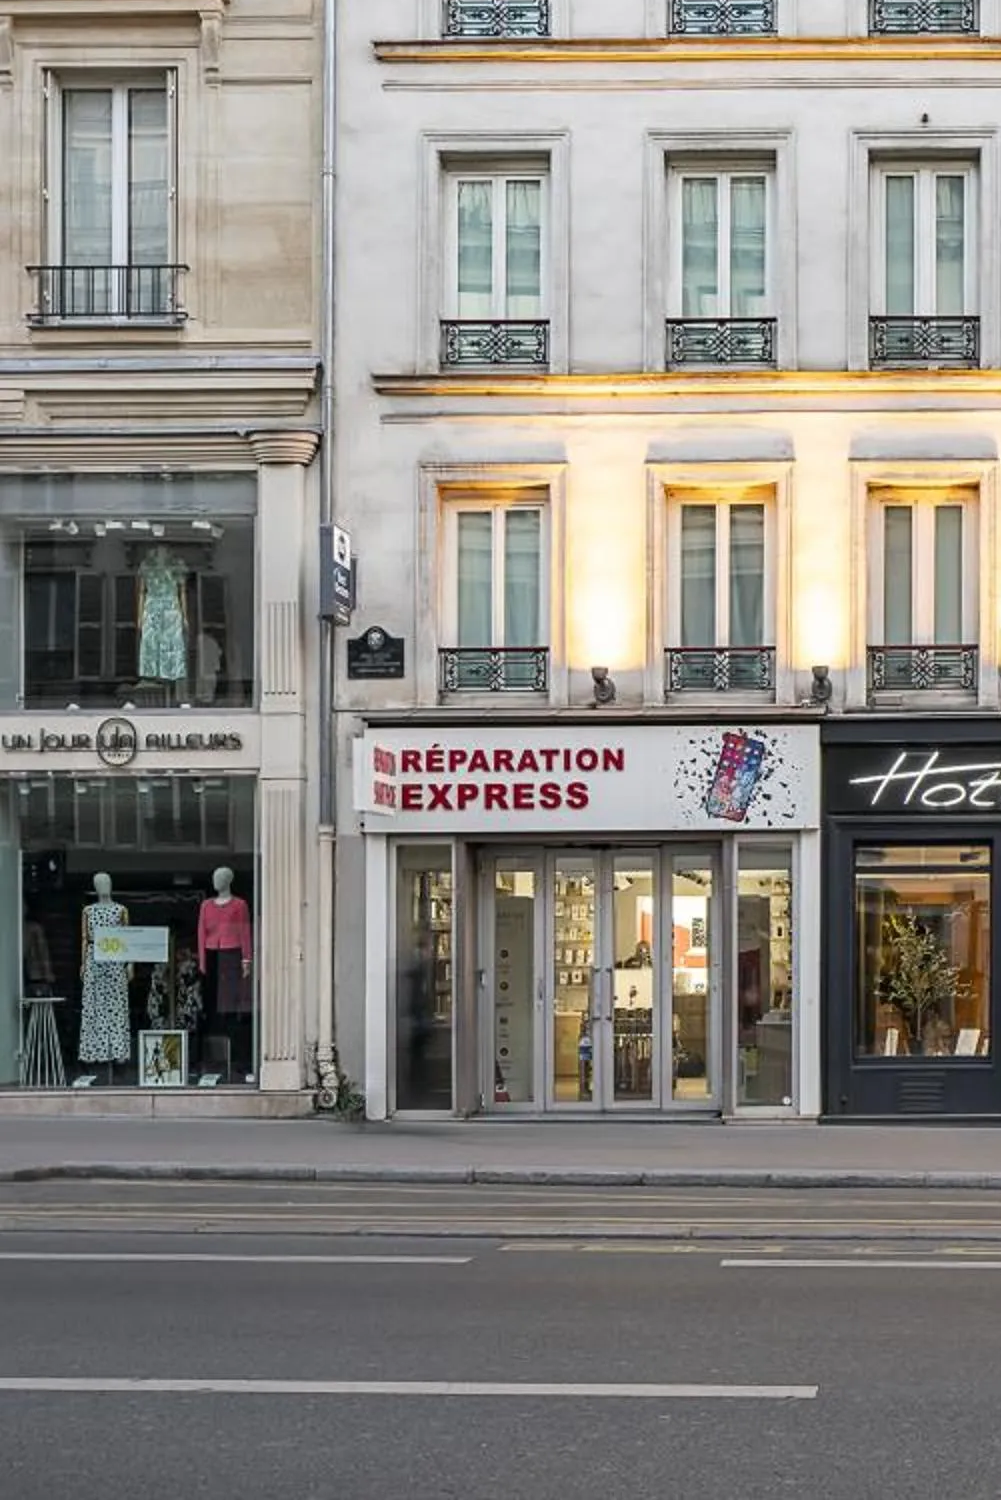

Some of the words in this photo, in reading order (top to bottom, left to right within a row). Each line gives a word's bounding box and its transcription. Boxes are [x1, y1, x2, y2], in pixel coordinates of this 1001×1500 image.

[2, 734, 32, 749] UN
[401, 743, 625, 773] RÉPARATION
[401, 782, 590, 811] EXPRESS
